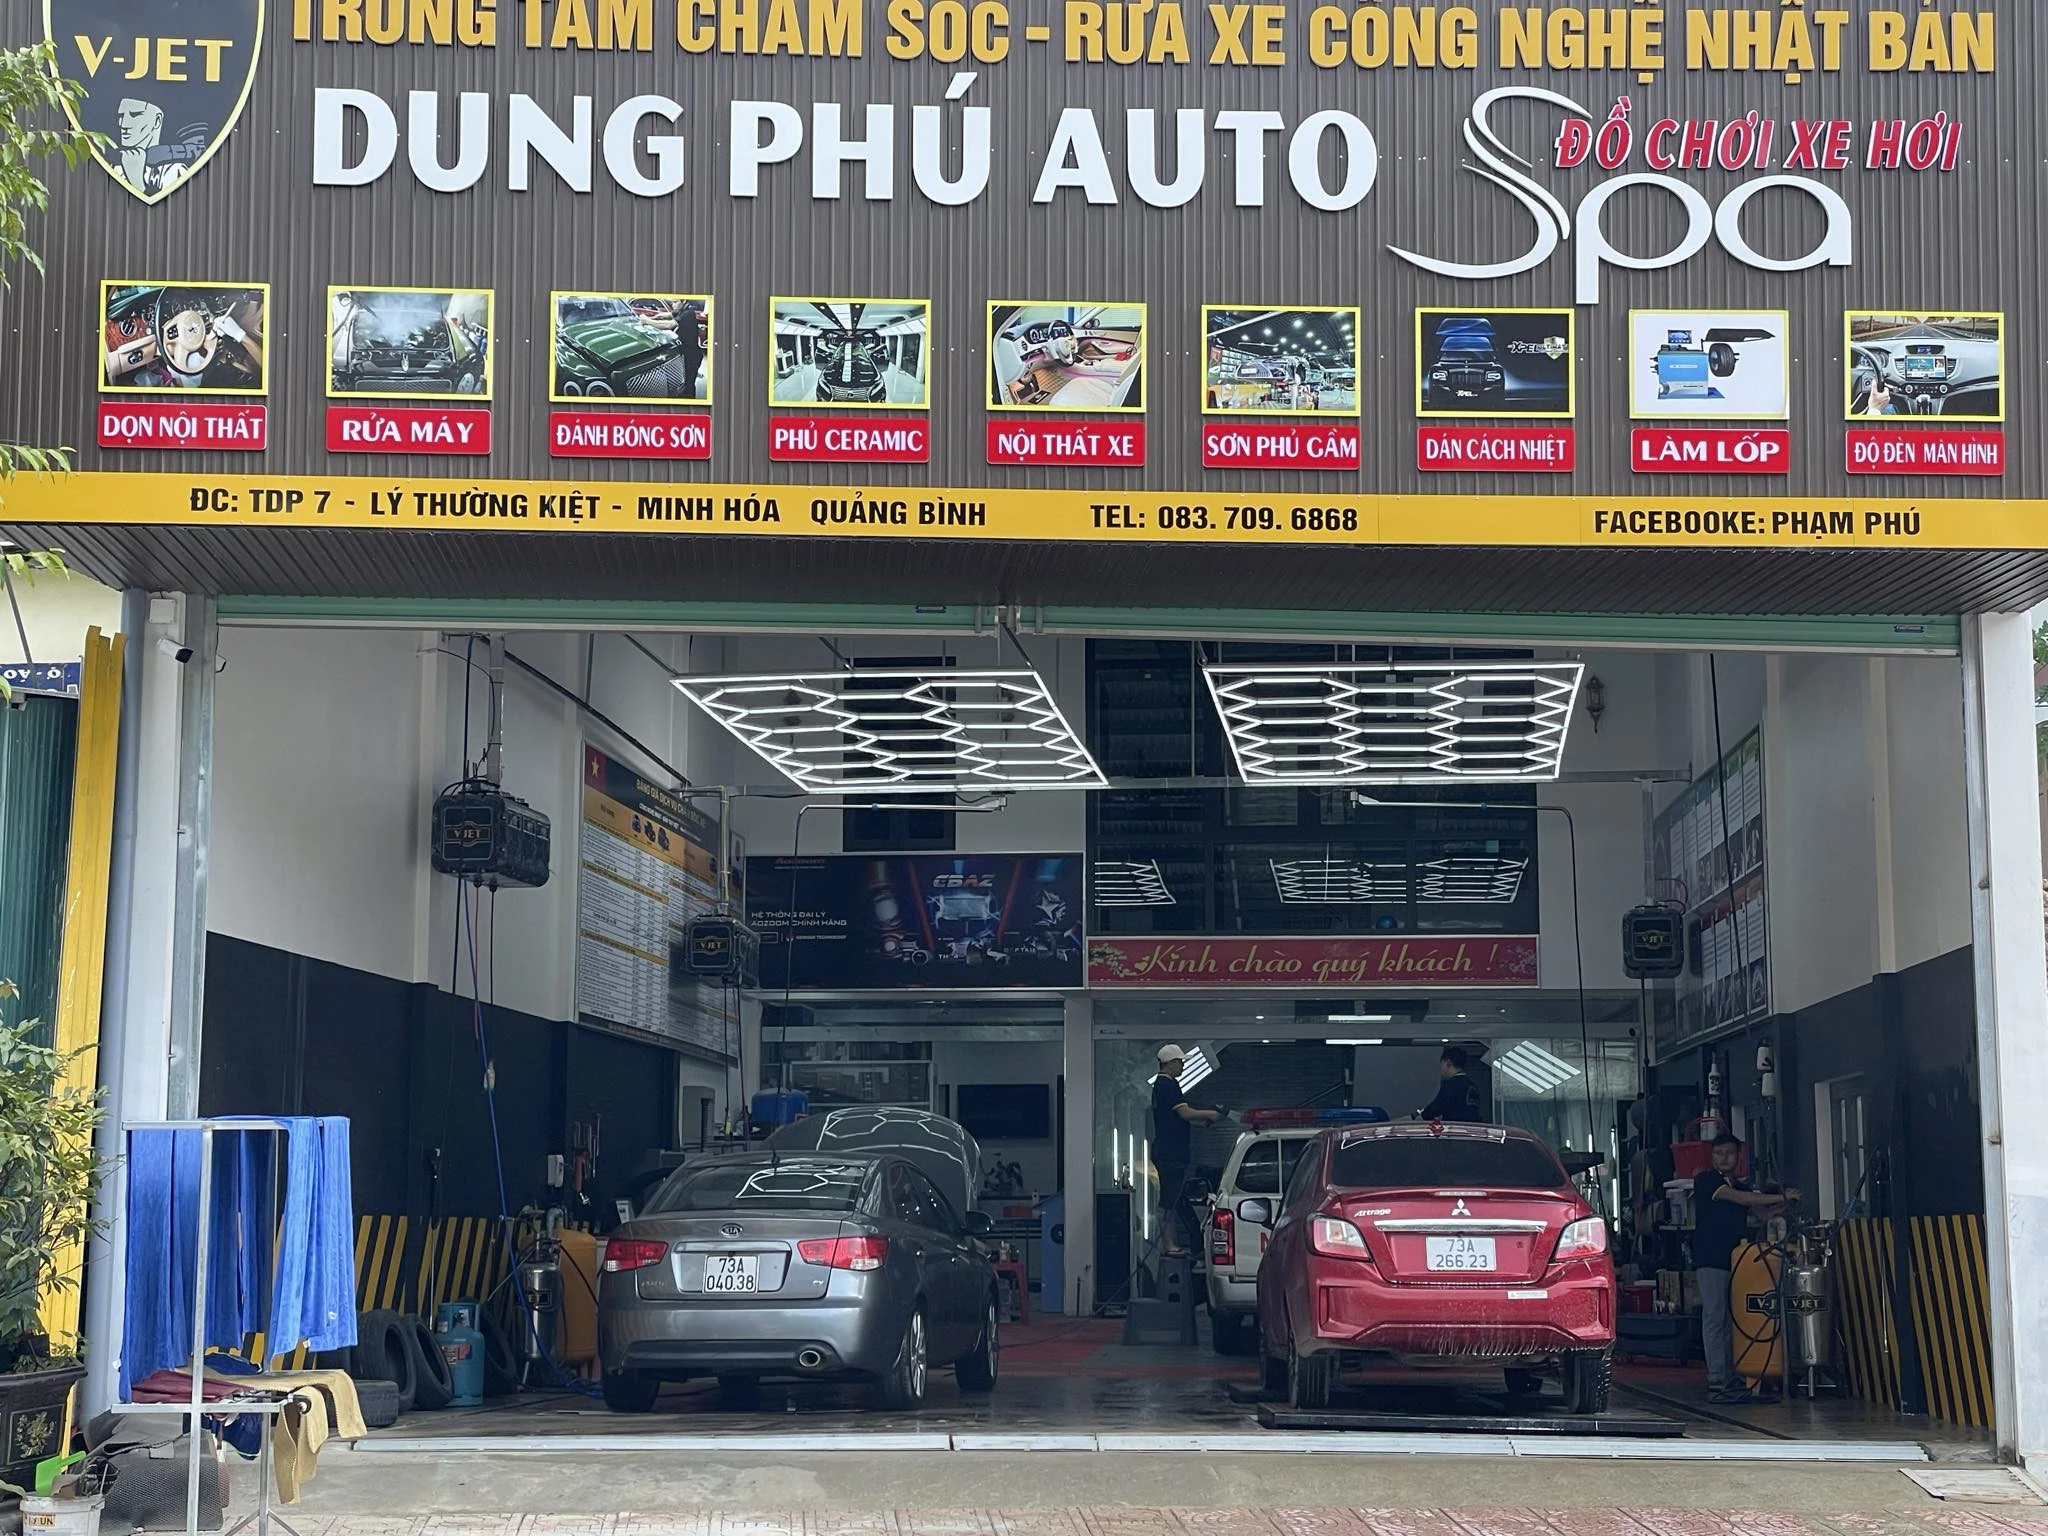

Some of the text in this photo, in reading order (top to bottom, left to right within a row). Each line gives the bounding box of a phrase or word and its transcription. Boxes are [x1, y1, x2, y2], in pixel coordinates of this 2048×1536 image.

[1209, 4, 1286, 66] XE
[74, 35, 233, 82] V-JET
[1555, 95, 1963, 171] ĐỒ CHƠI XE HƠI
[312, 71, 1853, 305] DUNG PHÚ AUTO Spa
[103, 409, 263, 445] DỌN NỘI THẤT
[342, 412, 474, 443] RỬA MÁY
[556, 418, 706, 448] ĐÁNH BÓNG SƠN
[775, 420, 923, 452] PHỦ CERAMIC
[1207, 428, 1357, 458] SƠN PHỦ GẦM
[998, 426, 1134, 461] NỘI THẤT XE
[1426, 433, 1567, 466] DÁN CÁCH NHIỆT
[1641, 432, 1780, 463] LÀM LỐP
[1854, 436, 1998, 470] ĐỘ ĐÈN MÀN HÌNH
[189, 487, 239, 512] ĐC:
[248, 489, 304, 514] TDP
[314, 490, 331, 514] 7
[371, 487, 403, 516] LÝ
[413, 487, 528, 519] THƯỜNG
[539, 489, 601, 524] KIỆT
[638, 496, 714, 522] MINH
[724, 492, 781, 523] HÓA
[810, 491, 908, 526] QUẢNG
[918, 495, 987, 527] BÌNH
[1090, 504, 1358, 531] TEL: 083. 709. 6868
[1595, 506, 1921, 540] FACEBOOKE: PHẠM PHÚ
[453, 829, 480, 839] VJET
[1228, 944, 1302, 973] chào
[1312, 951, 1371, 982] quý
[1378, 944, 1473, 973] khách
[1435, 1254, 1488, 1269] 266.23
[1446, 1238, 1475, 1253] 73A
[719, 1257, 744, 1274] 73A
[706, 1274, 755, 1291] 040.38
